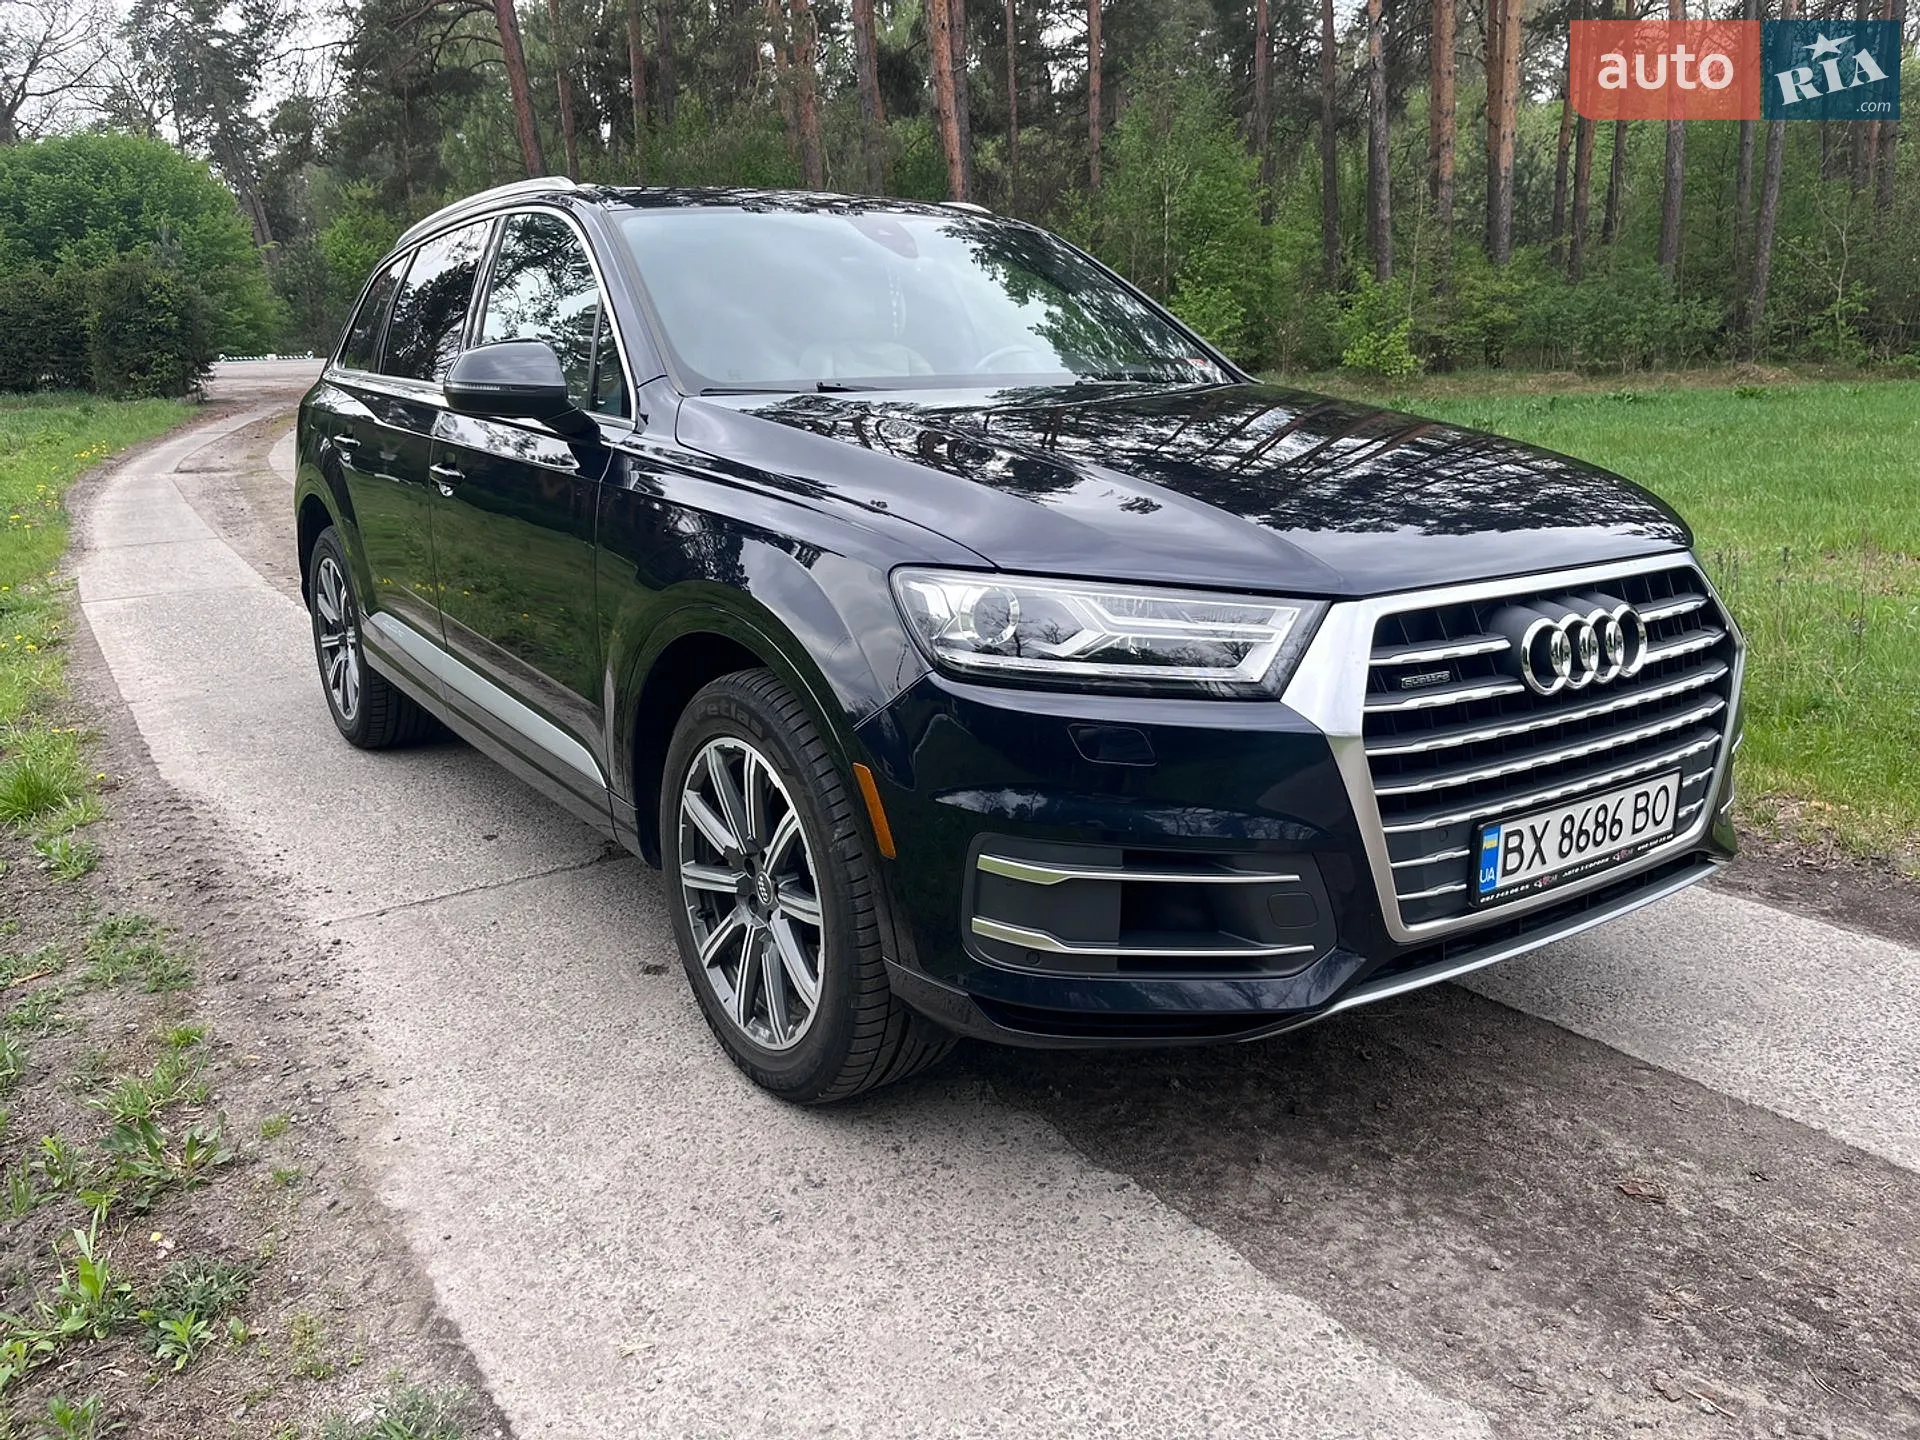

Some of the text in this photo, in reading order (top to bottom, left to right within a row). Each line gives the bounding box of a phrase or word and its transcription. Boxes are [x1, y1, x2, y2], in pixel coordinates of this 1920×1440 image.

[1501, 784, 1670, 879] BX 8686 BO
[1479, 867, 1496, 884] UA
